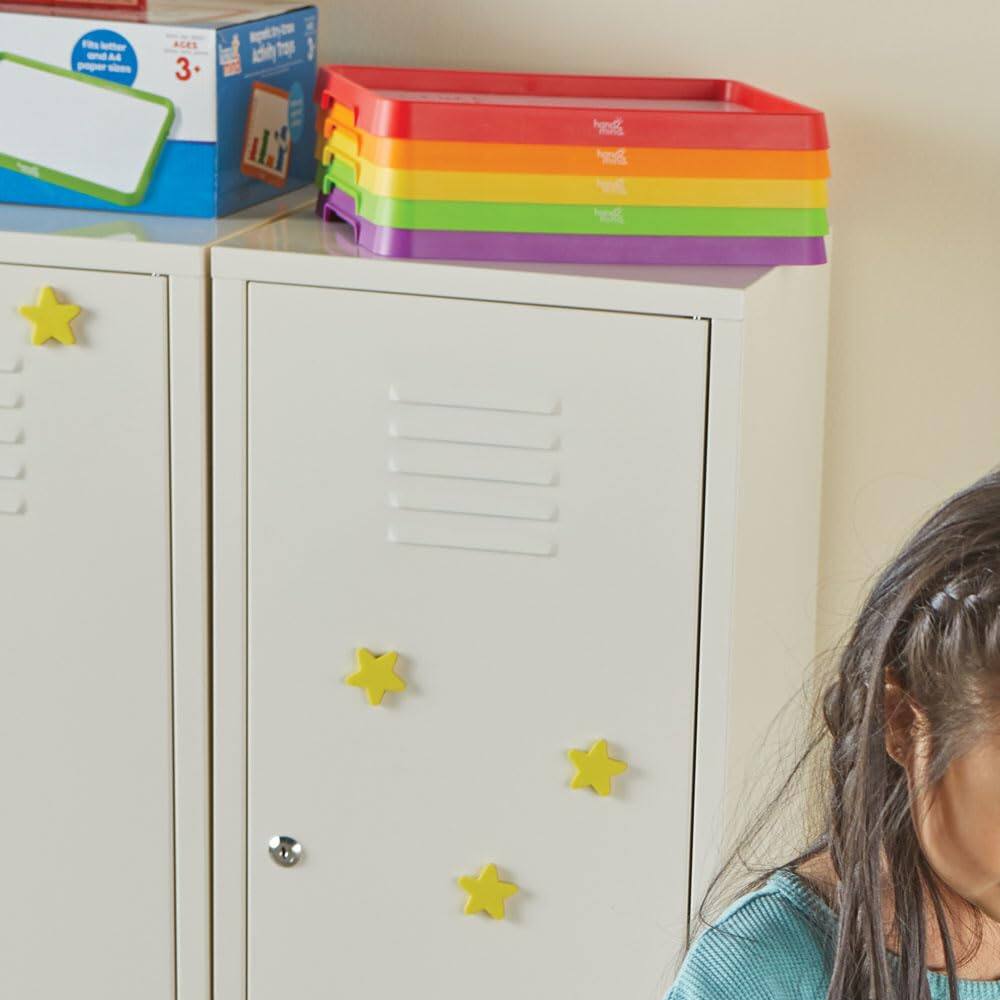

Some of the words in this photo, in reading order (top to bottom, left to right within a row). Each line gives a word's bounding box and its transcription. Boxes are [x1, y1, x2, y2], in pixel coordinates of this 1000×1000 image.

[82, 39, 99, 49] Fits
[100, 41, 127, 51] letter
[174, 41, 198, 49] AGES
[87, 51, 107, 61] and
[109, 52, 122, 61] A4
[77, 61, 106, 72] paper
[108, 63, 132, 74] sizes
[175, 56, 201, 81] 3+
